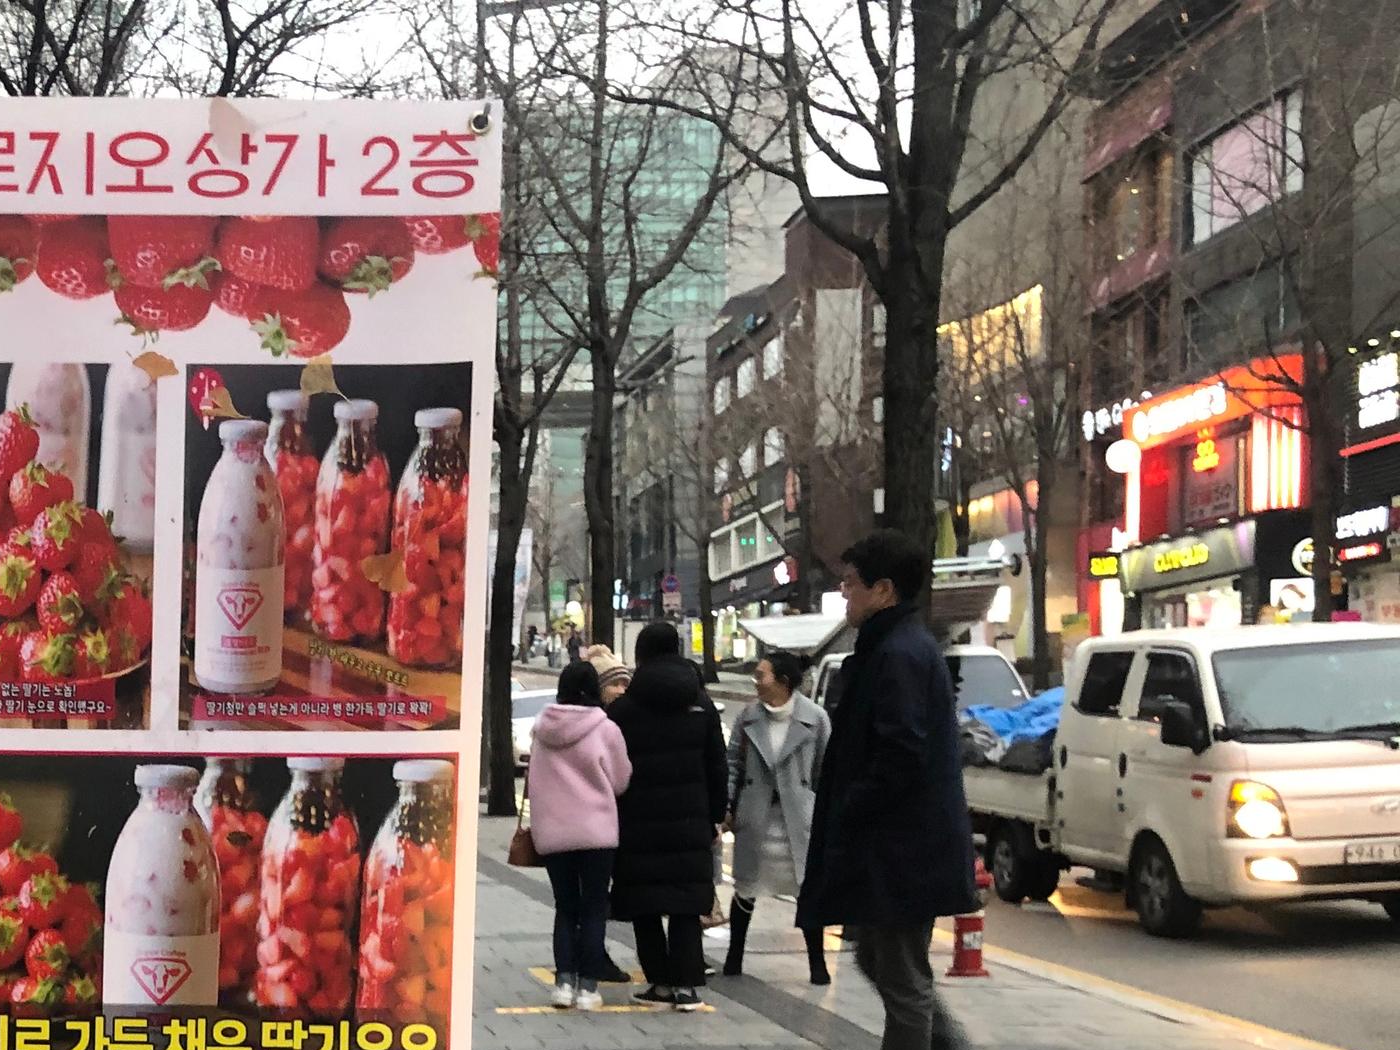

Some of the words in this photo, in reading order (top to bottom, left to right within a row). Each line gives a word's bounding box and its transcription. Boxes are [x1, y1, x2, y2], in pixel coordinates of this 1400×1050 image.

[361, 128, 480, 198] 2층
[23, 683, 51, 697] 딸기는
[5, 699, 25, 714] 딸기
[27, 699, 55, 714] 눈으로
[300, 702, 329, 716] 아니라
[345, 702, 374, 717] 한가득
